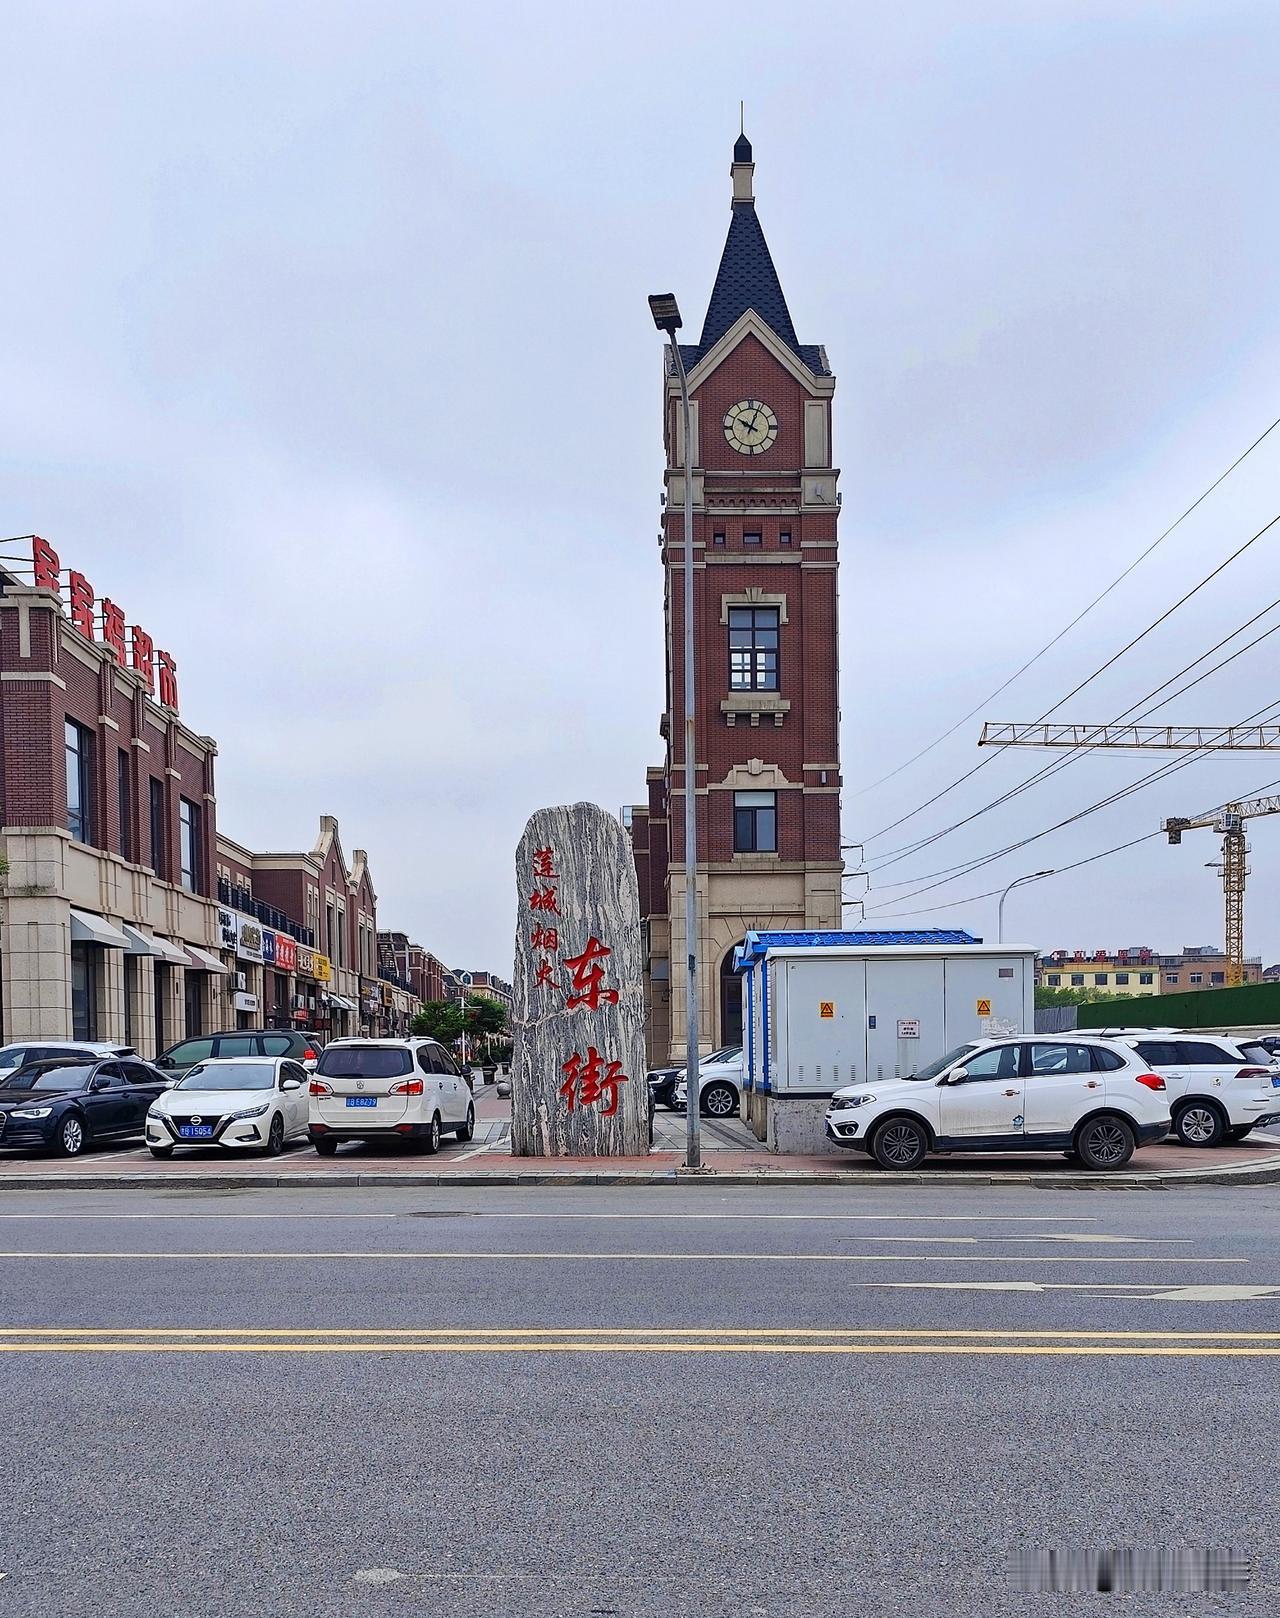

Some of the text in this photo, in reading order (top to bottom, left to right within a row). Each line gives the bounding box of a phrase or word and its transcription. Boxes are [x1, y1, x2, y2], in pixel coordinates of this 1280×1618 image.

[529, 847, 561, 990] 莲城烟火
[560, 935, 629, 1119] 东街
